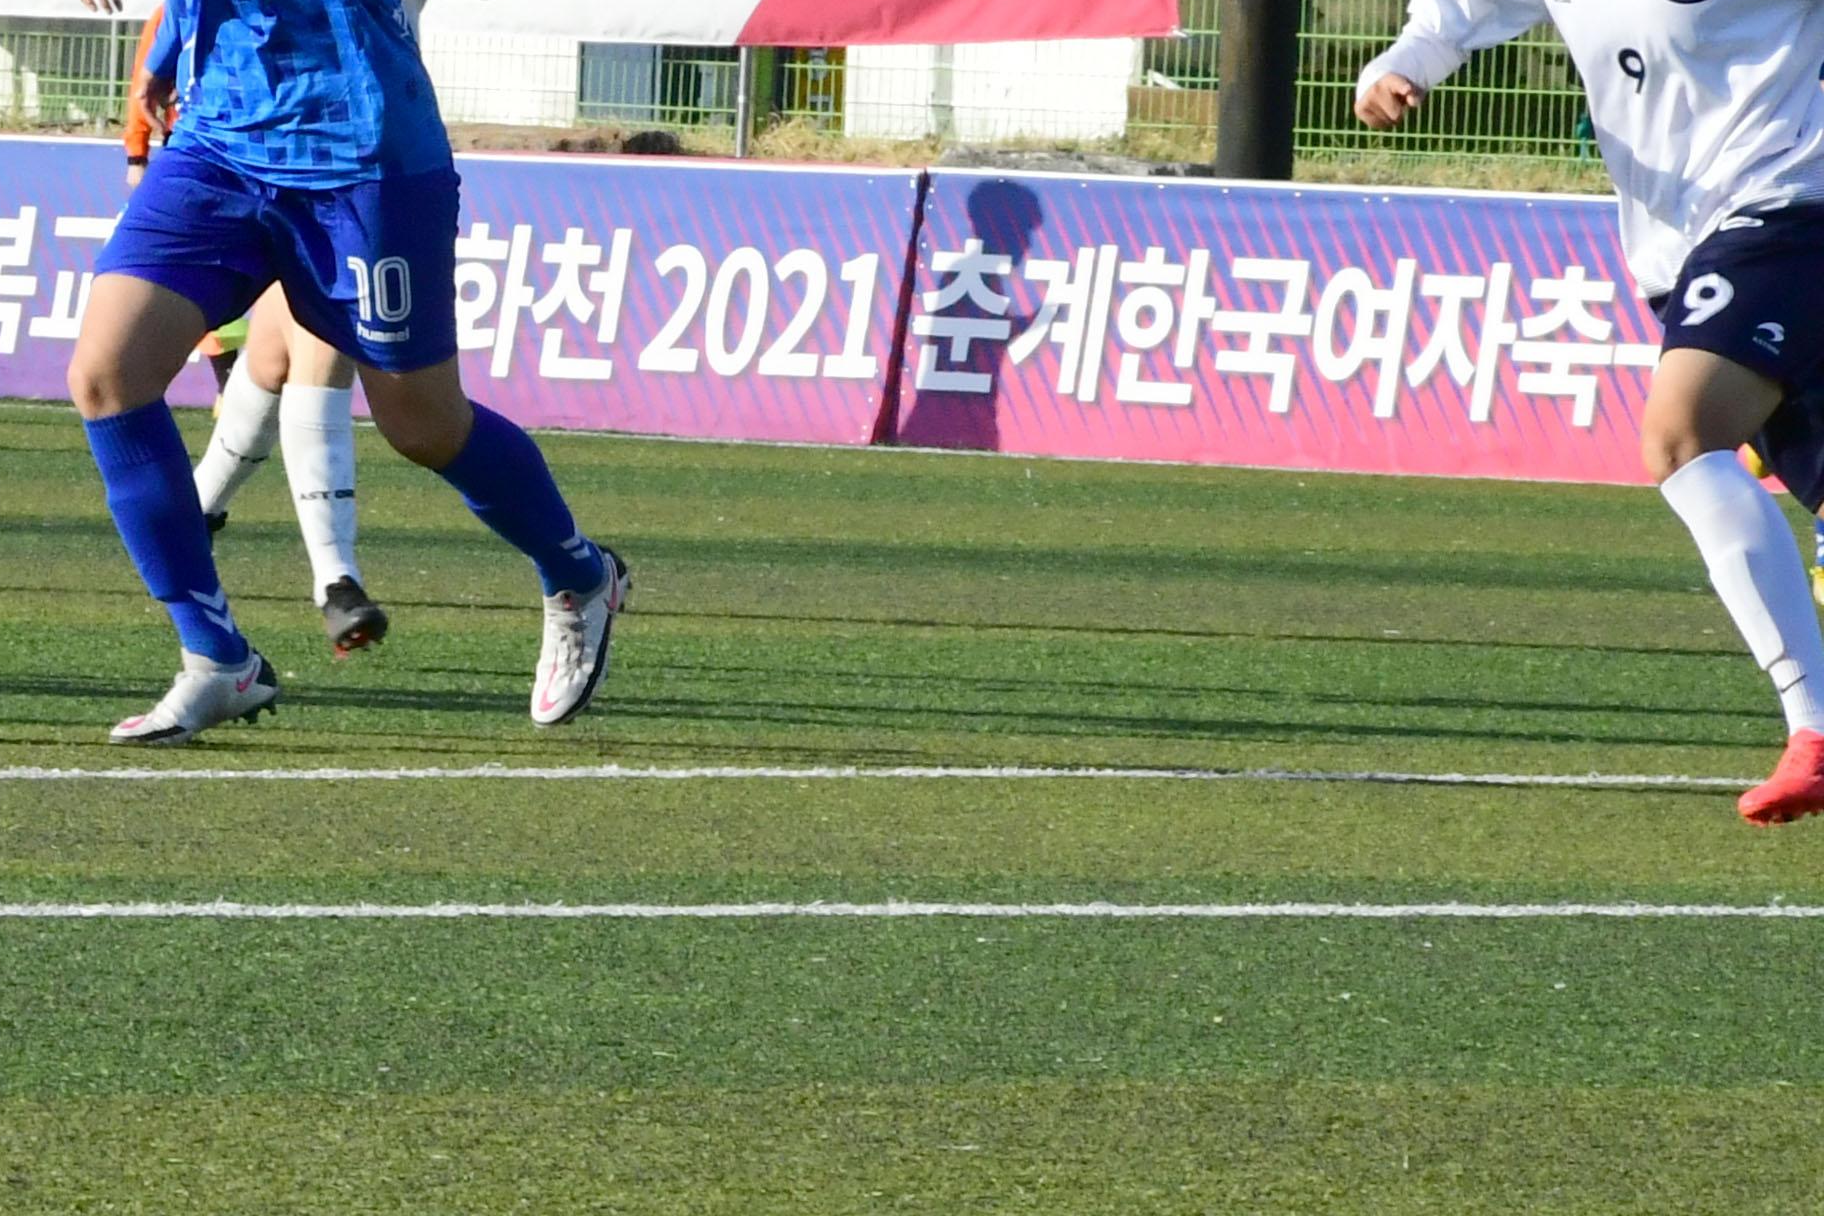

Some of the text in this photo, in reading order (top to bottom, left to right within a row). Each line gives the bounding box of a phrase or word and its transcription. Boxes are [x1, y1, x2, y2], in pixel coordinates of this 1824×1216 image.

[1618, 48, 1645, 95] 9
[347, 255, 412, 323] 10
[1679, 272, 1735, 326] 9
[455, 222, 633, 381] 화천
[637, 244, 879, 379] 2021
[911, 238, 1662, 430] 춘계한국여자축
